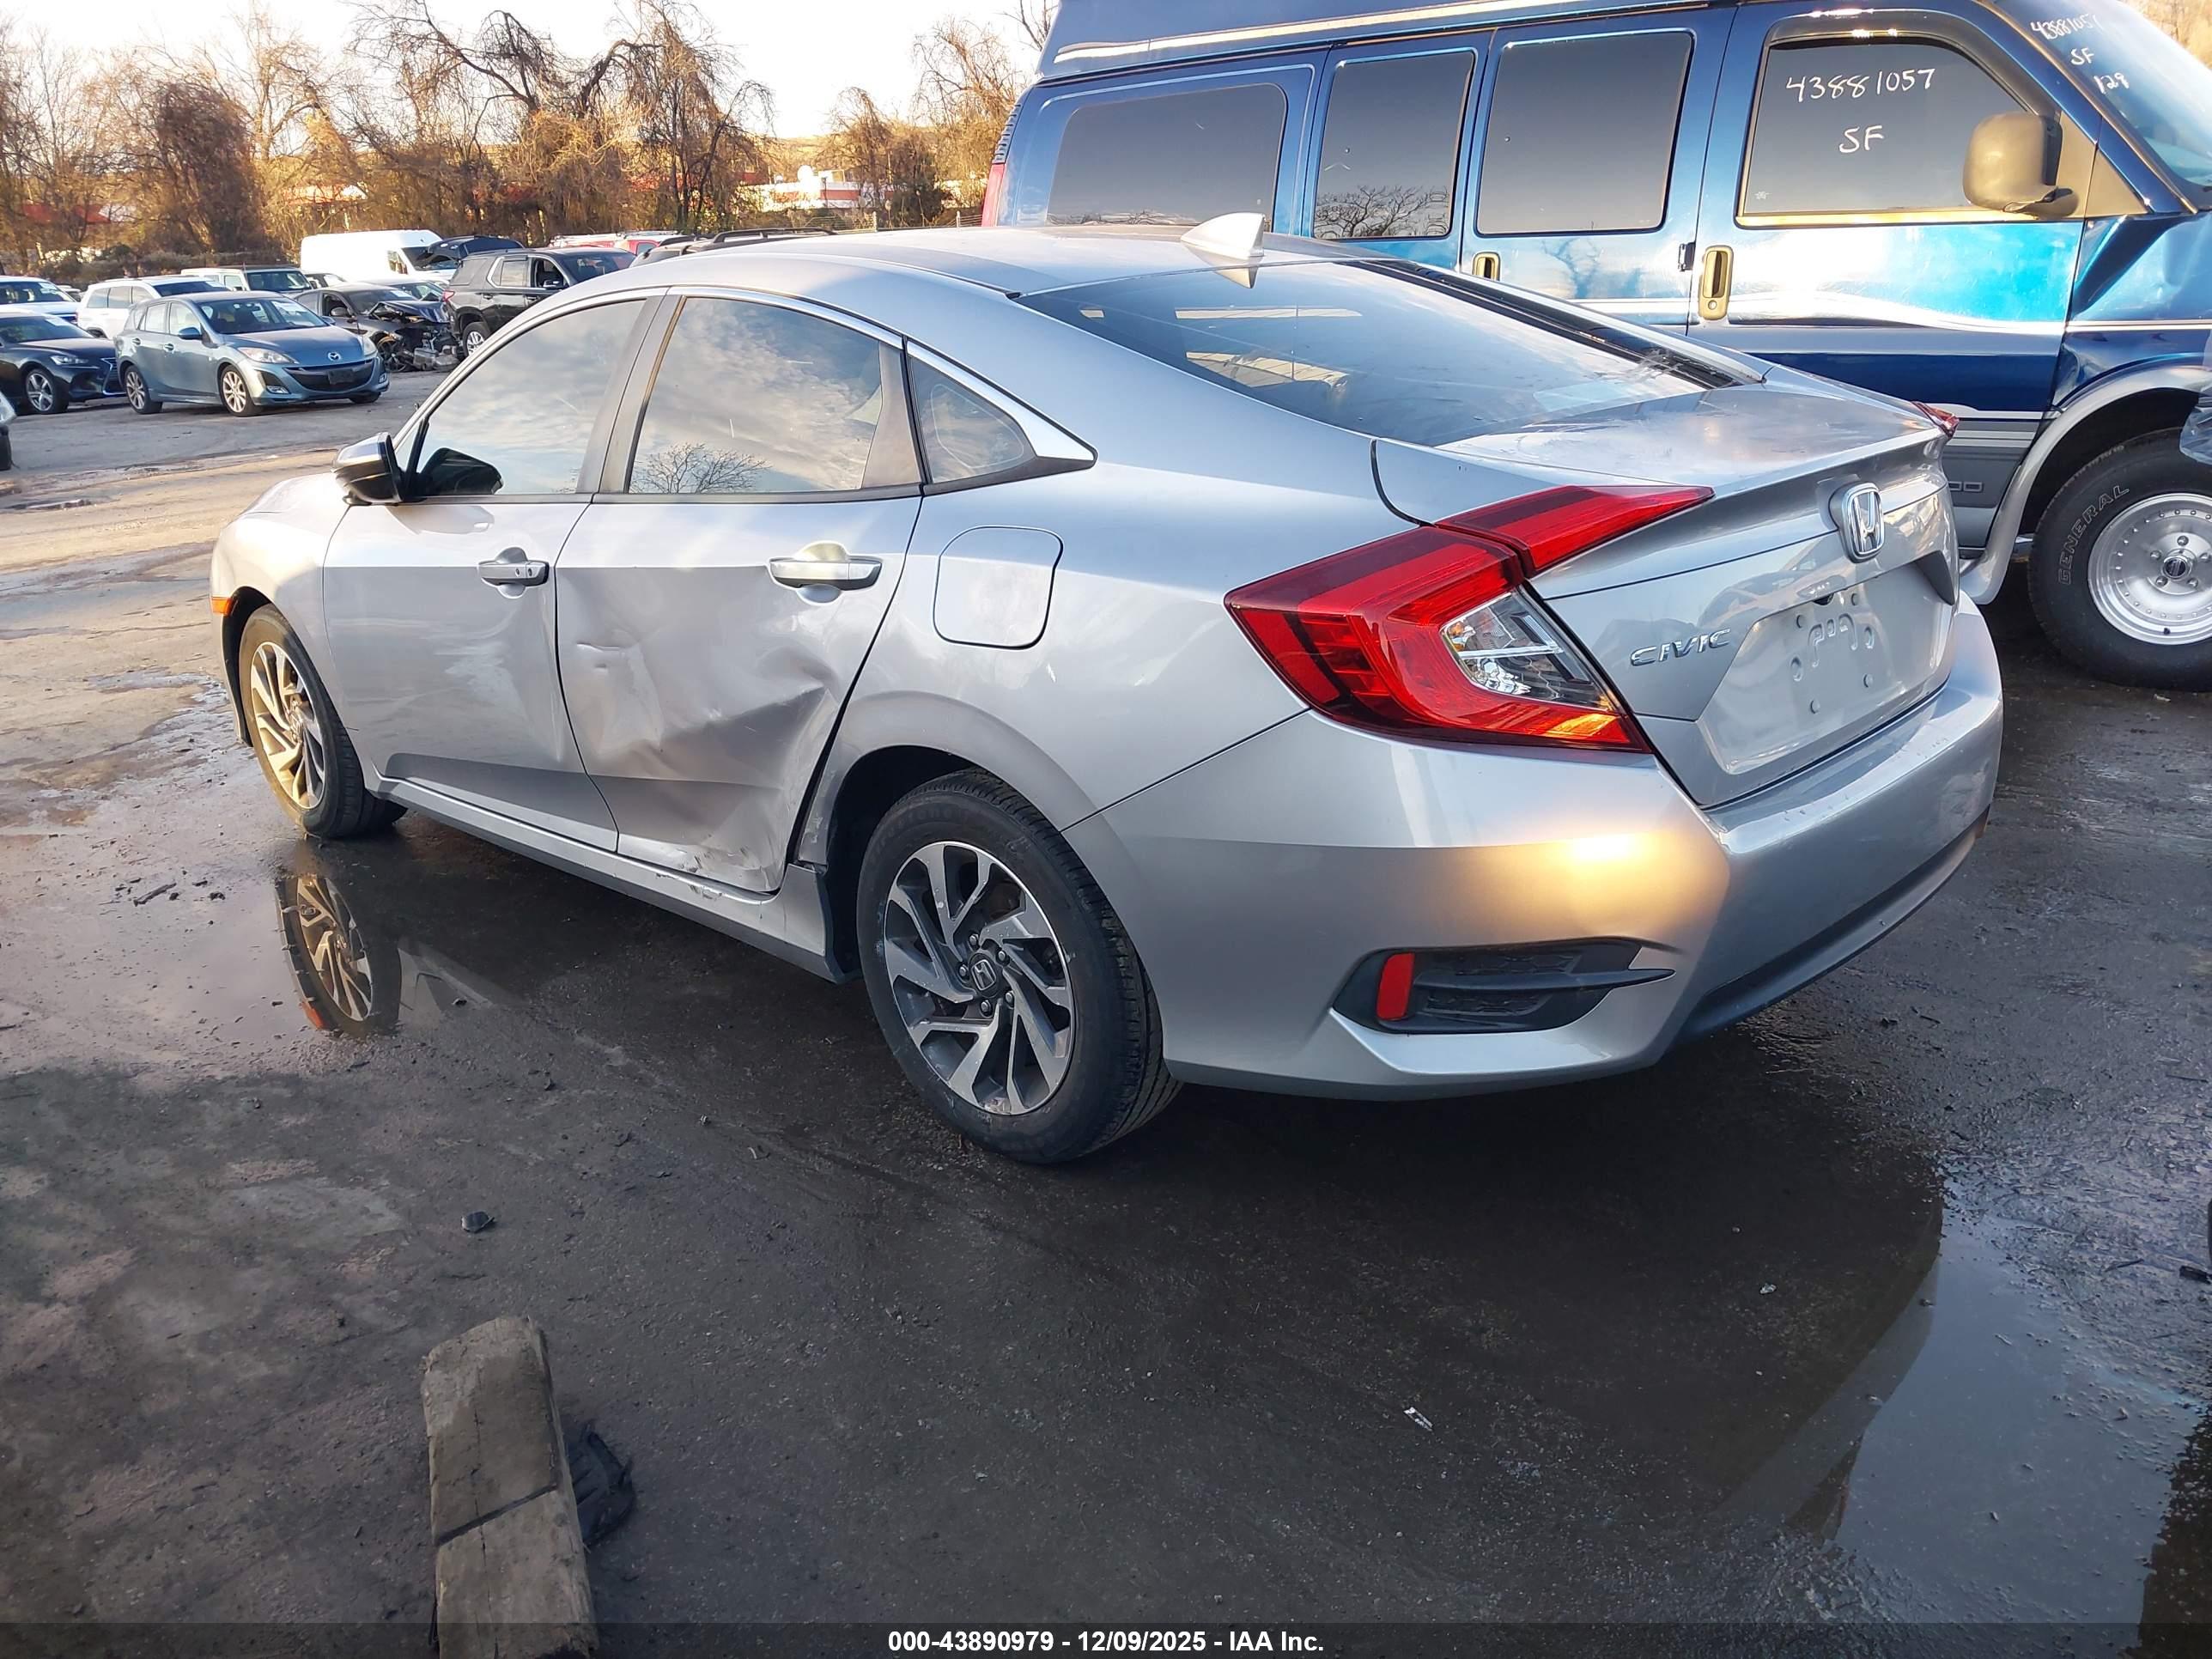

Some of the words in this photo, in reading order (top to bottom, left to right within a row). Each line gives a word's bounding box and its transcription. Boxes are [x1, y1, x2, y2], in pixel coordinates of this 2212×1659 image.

[2070, 47, 2095, 65] SF
[1785, 68, 1936, 103] 43881057
[1838, 125, 1885, 154] SF
[2058, 485, 2130, 585] GENERAL
[1631, 628, 1731, 666] CIVIC
